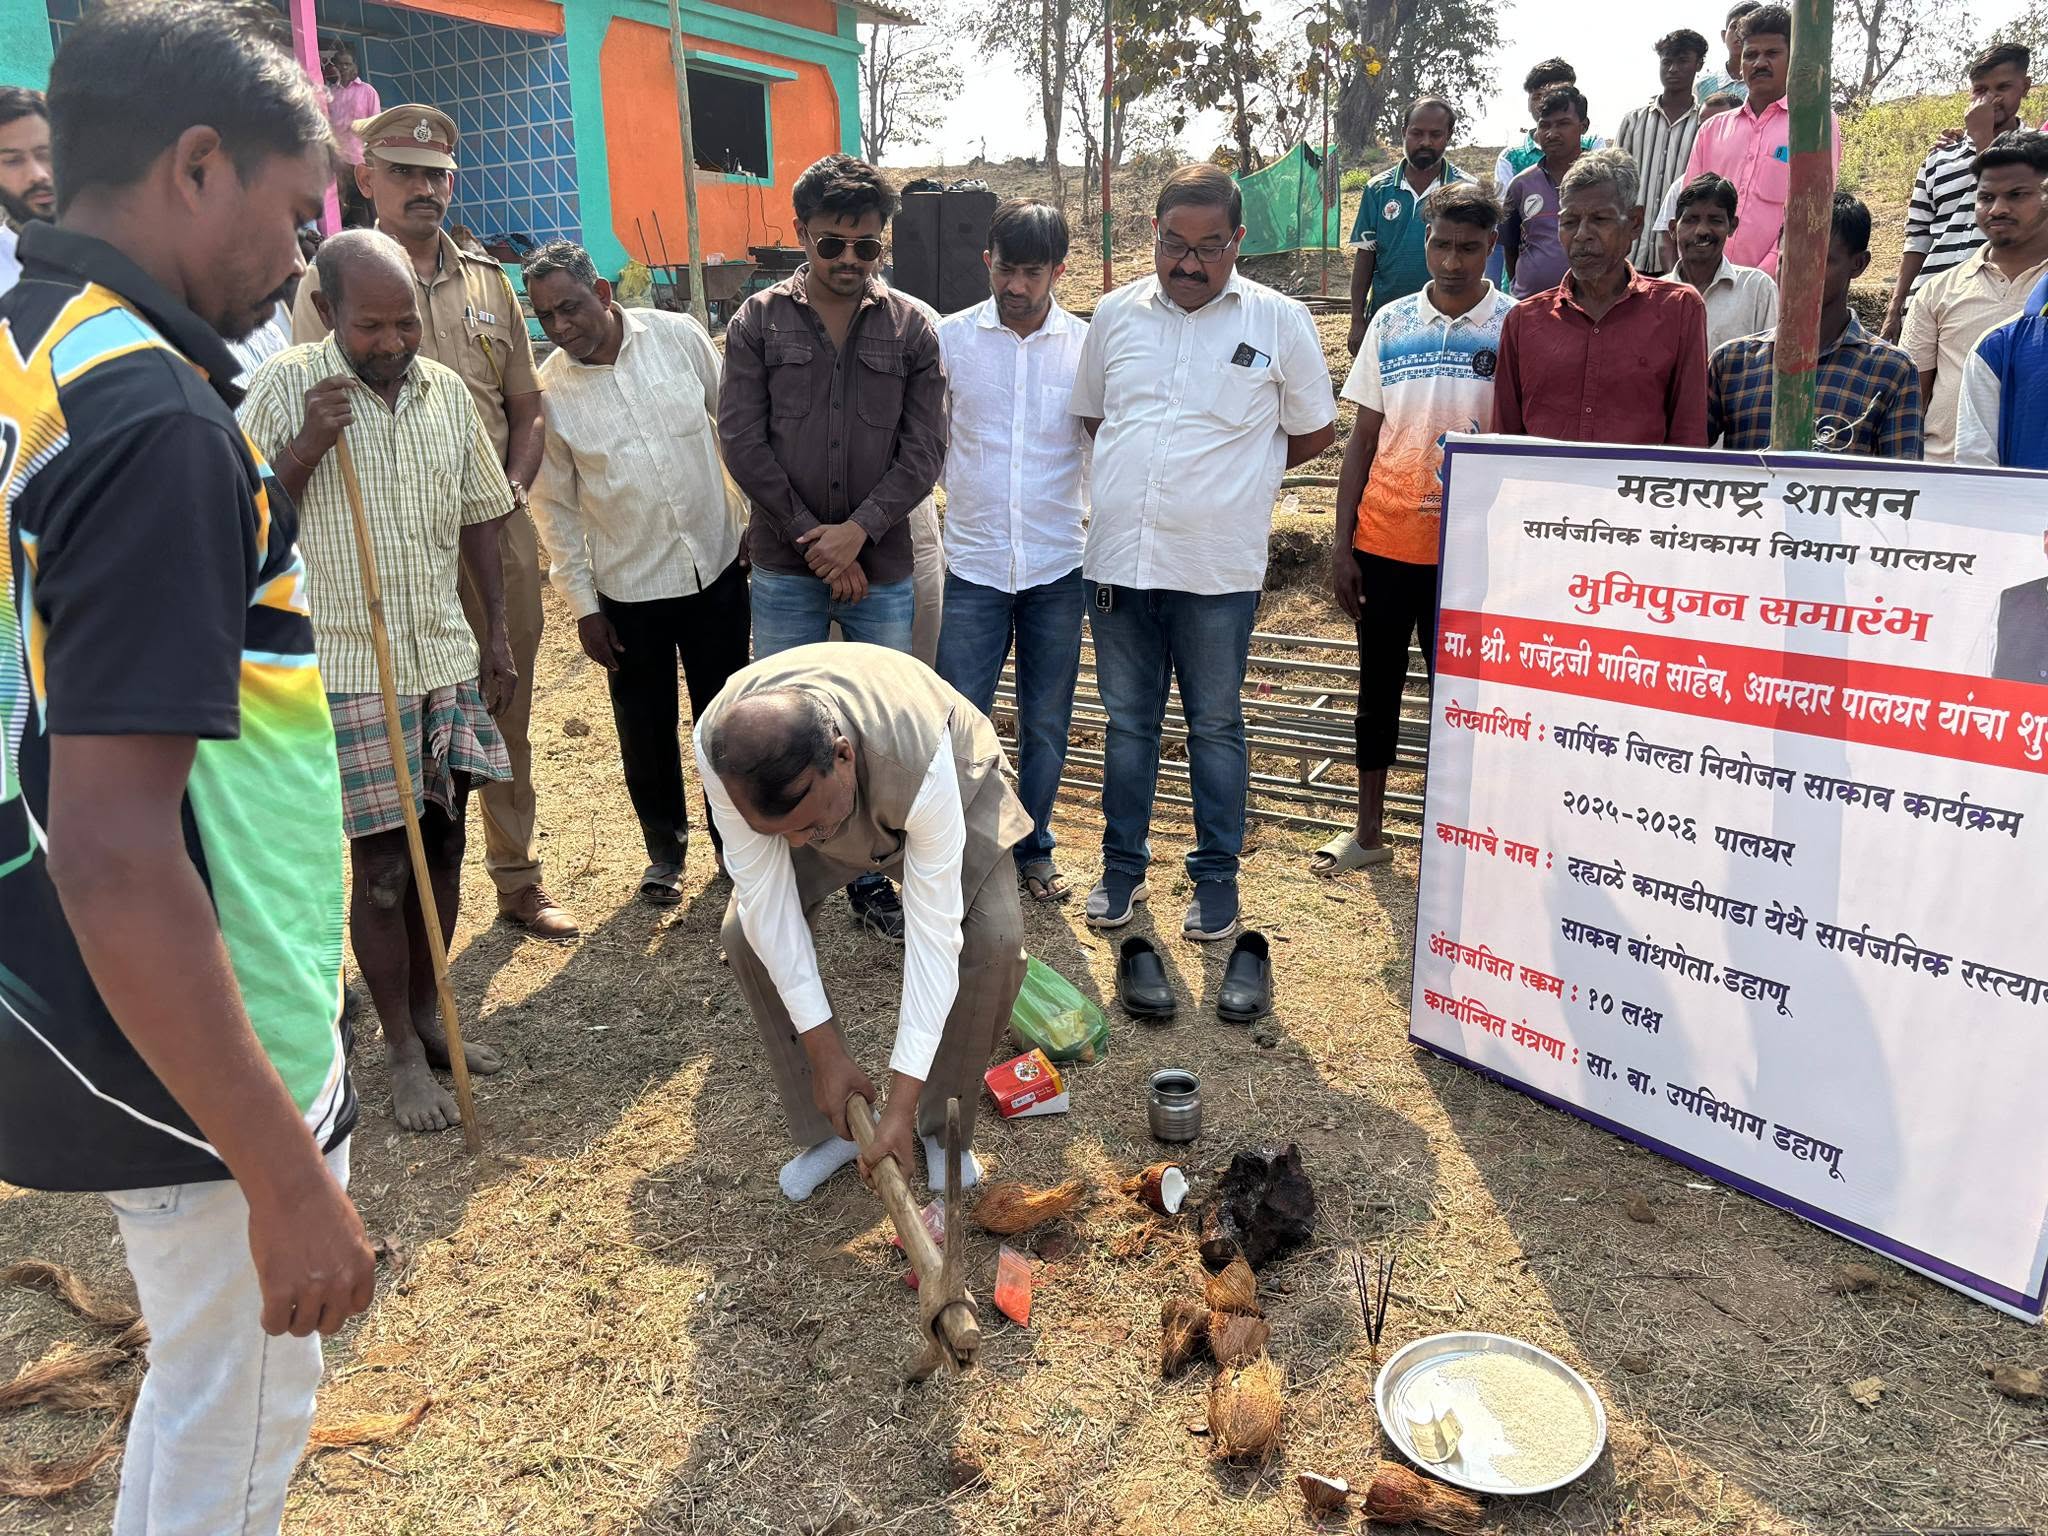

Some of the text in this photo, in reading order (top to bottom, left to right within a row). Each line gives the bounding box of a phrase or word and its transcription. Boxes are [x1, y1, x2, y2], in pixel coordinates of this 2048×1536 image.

[1617, 475, 1920, 521] महाराष्ट्र शासन
[1523, 516, 1977, 576] सार्वजनिक बांधकाम विभाग पालघर
[1568, 570, 1934, 643] भुमिपुजन समारंभ
[1444, 627, 2048, 761] मा. श्री. राजेंद्रजी गावित साहेब, आमदार पालघर यांचा शु
[1445, 699, 1532, 742] लेखाशिर्ष
[1553, 721, 1620, 757] वार्षिक
[1625, 731, 1693, 774] जिल्हा
[1700, 744, 1796, 794] नियोजन
[1803, 773, 1895, 813] साकाव
[1903, 791, 2024, 838] कार्यक्रम
[1563, 790, 1796, 867] २०२५-२०२६ पालघर
[1436, 822, 1499, 857] कामाचे
[1504, 839, 1540, 868] नाव
[1632, 873, 1758, 928] कामडीपाडा
[1765, 900, 1808, 941] येथे
[1815, 921, 1953, 978] सार्वजनिक
[1561, 917, 1622, 955] साकव
[1428, 930, 1515, 982] अंदाजजित
[1519, 966, 1565, 999] रक्कम
[1588, 987, 1614, 1015] १०
[1621, 1000, 1664, 1034] लक्ष
[1423, 988, 1507, 1038] कार्यान्वित
[1511, 1017, 1566, 1062] यंत्रणा
[1586, 1051, 1618, 1081] सा.
[1666, 1082, 1767, 1141] उपविभाग
[1773, 1123, 1846, 1183] डहाणू
